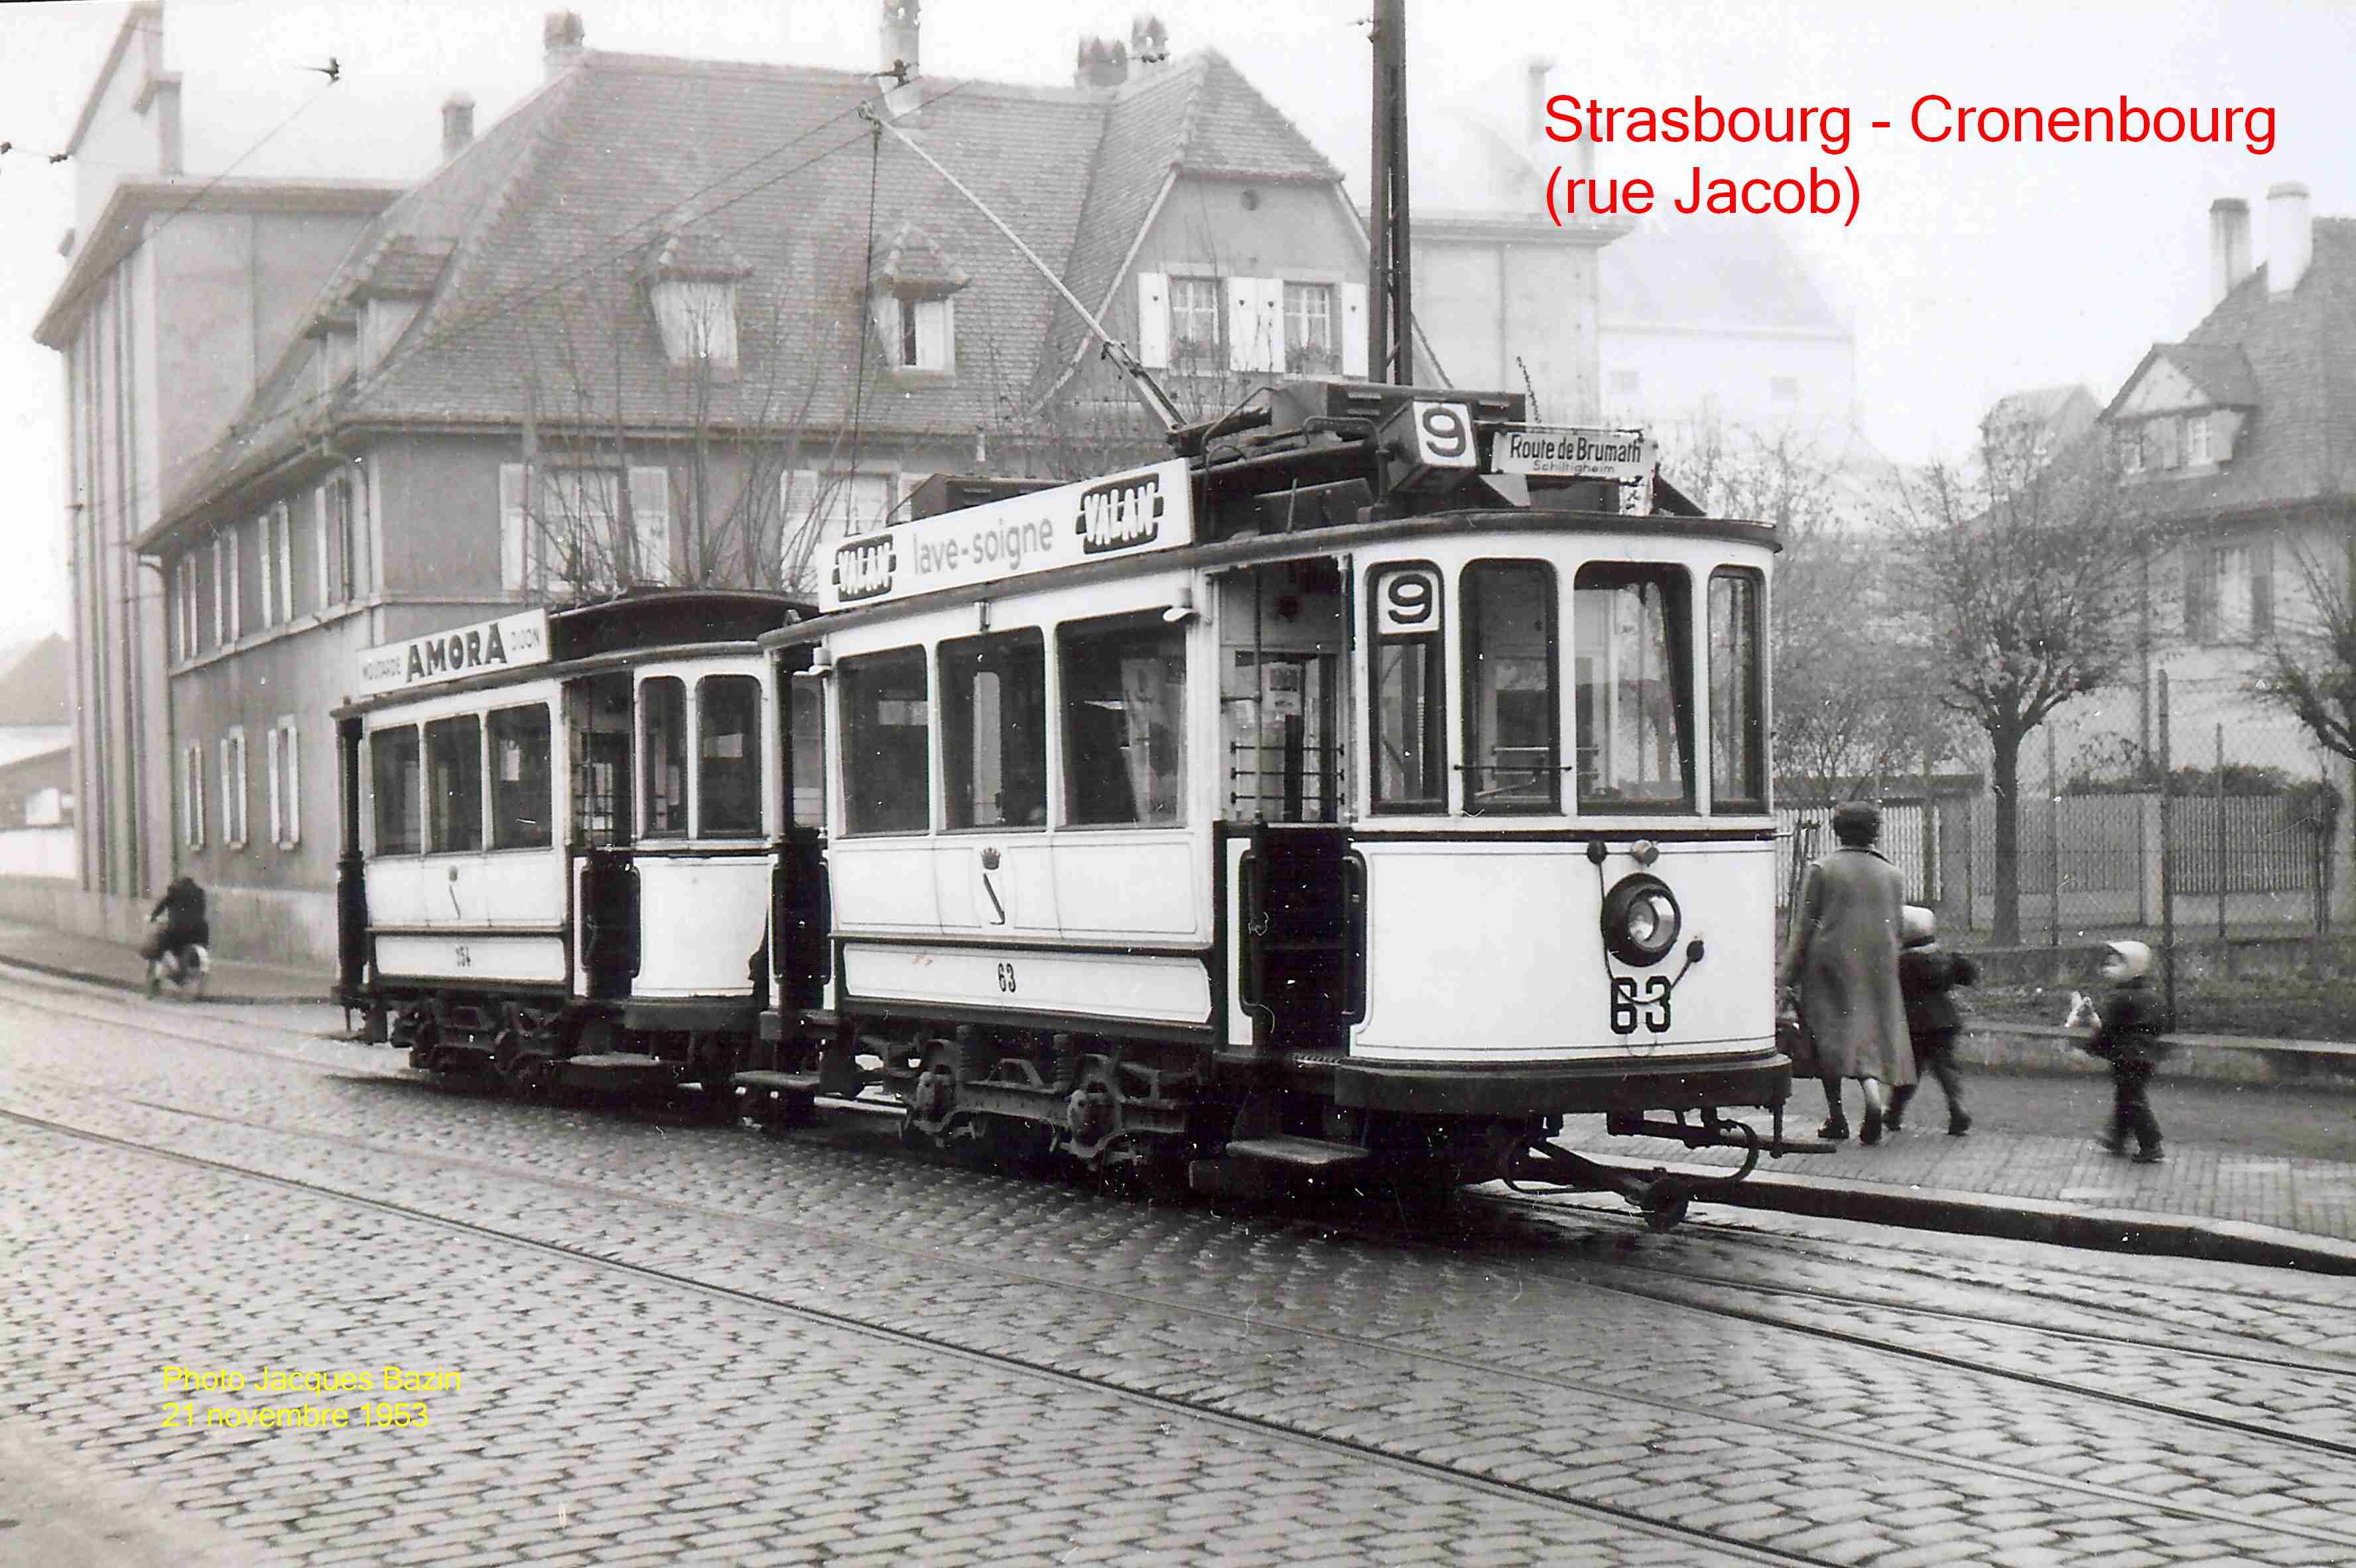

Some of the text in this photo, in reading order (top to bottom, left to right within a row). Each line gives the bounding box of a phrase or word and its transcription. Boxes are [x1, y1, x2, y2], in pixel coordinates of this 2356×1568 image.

[1422, 406, 1467, 458] 9
[1510, 434, 1642, 463] Route de Brumath
[838, 481, 1155, 596] VALAN lave-soigne VALAN
[1388, 574, 1433, 624] 9
[405, 622, 507, 683] AMORA
[998, 962, 1016, 993] 63
[1610, 976, 1671, 1035] 63
